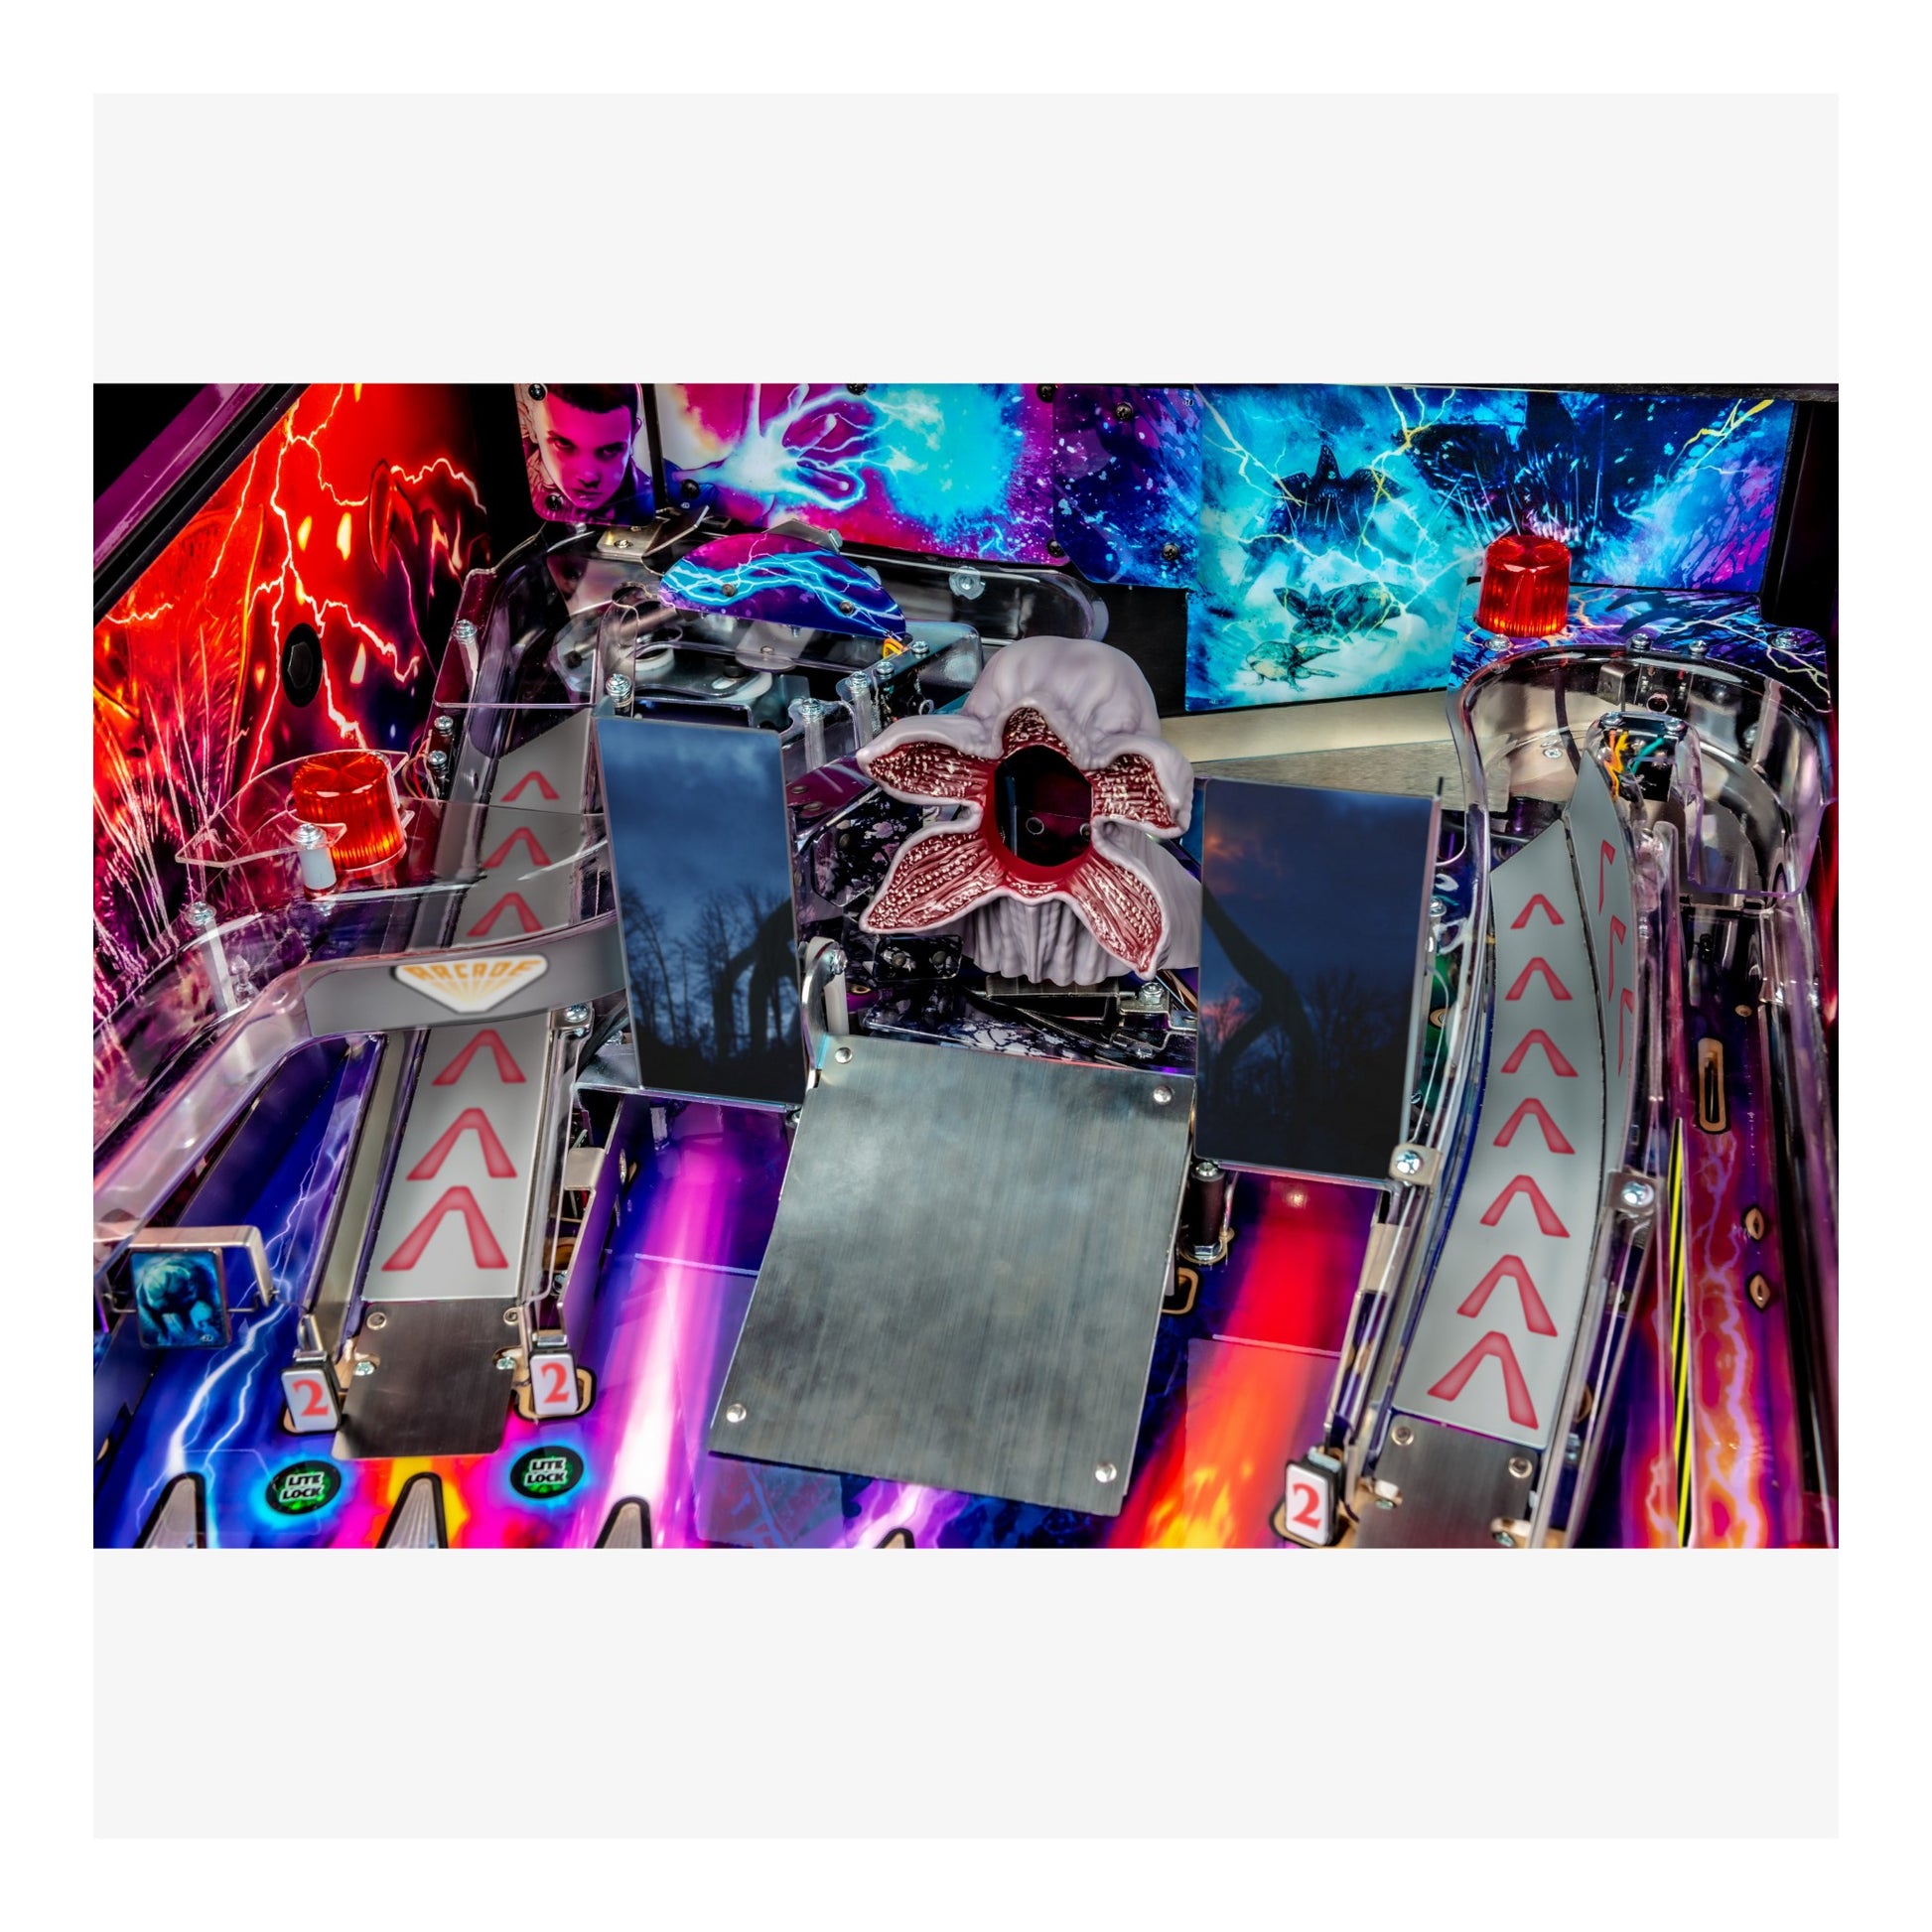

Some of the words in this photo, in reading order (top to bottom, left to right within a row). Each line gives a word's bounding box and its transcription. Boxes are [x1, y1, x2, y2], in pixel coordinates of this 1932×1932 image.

[402, 960, 542, 981] ARCADE
[541, 1362, 570, 1403] 2
[292, 1378, 329, 1417] 2
[531, 1458, 566, 1472] LITE
[287, 1472, 324, 1487] LITE
[526, 1471, 566, 1485] LOCK
[281, 1486, 323, 1501] LOCK
[1293, 1482, 1321, 1530] 2
